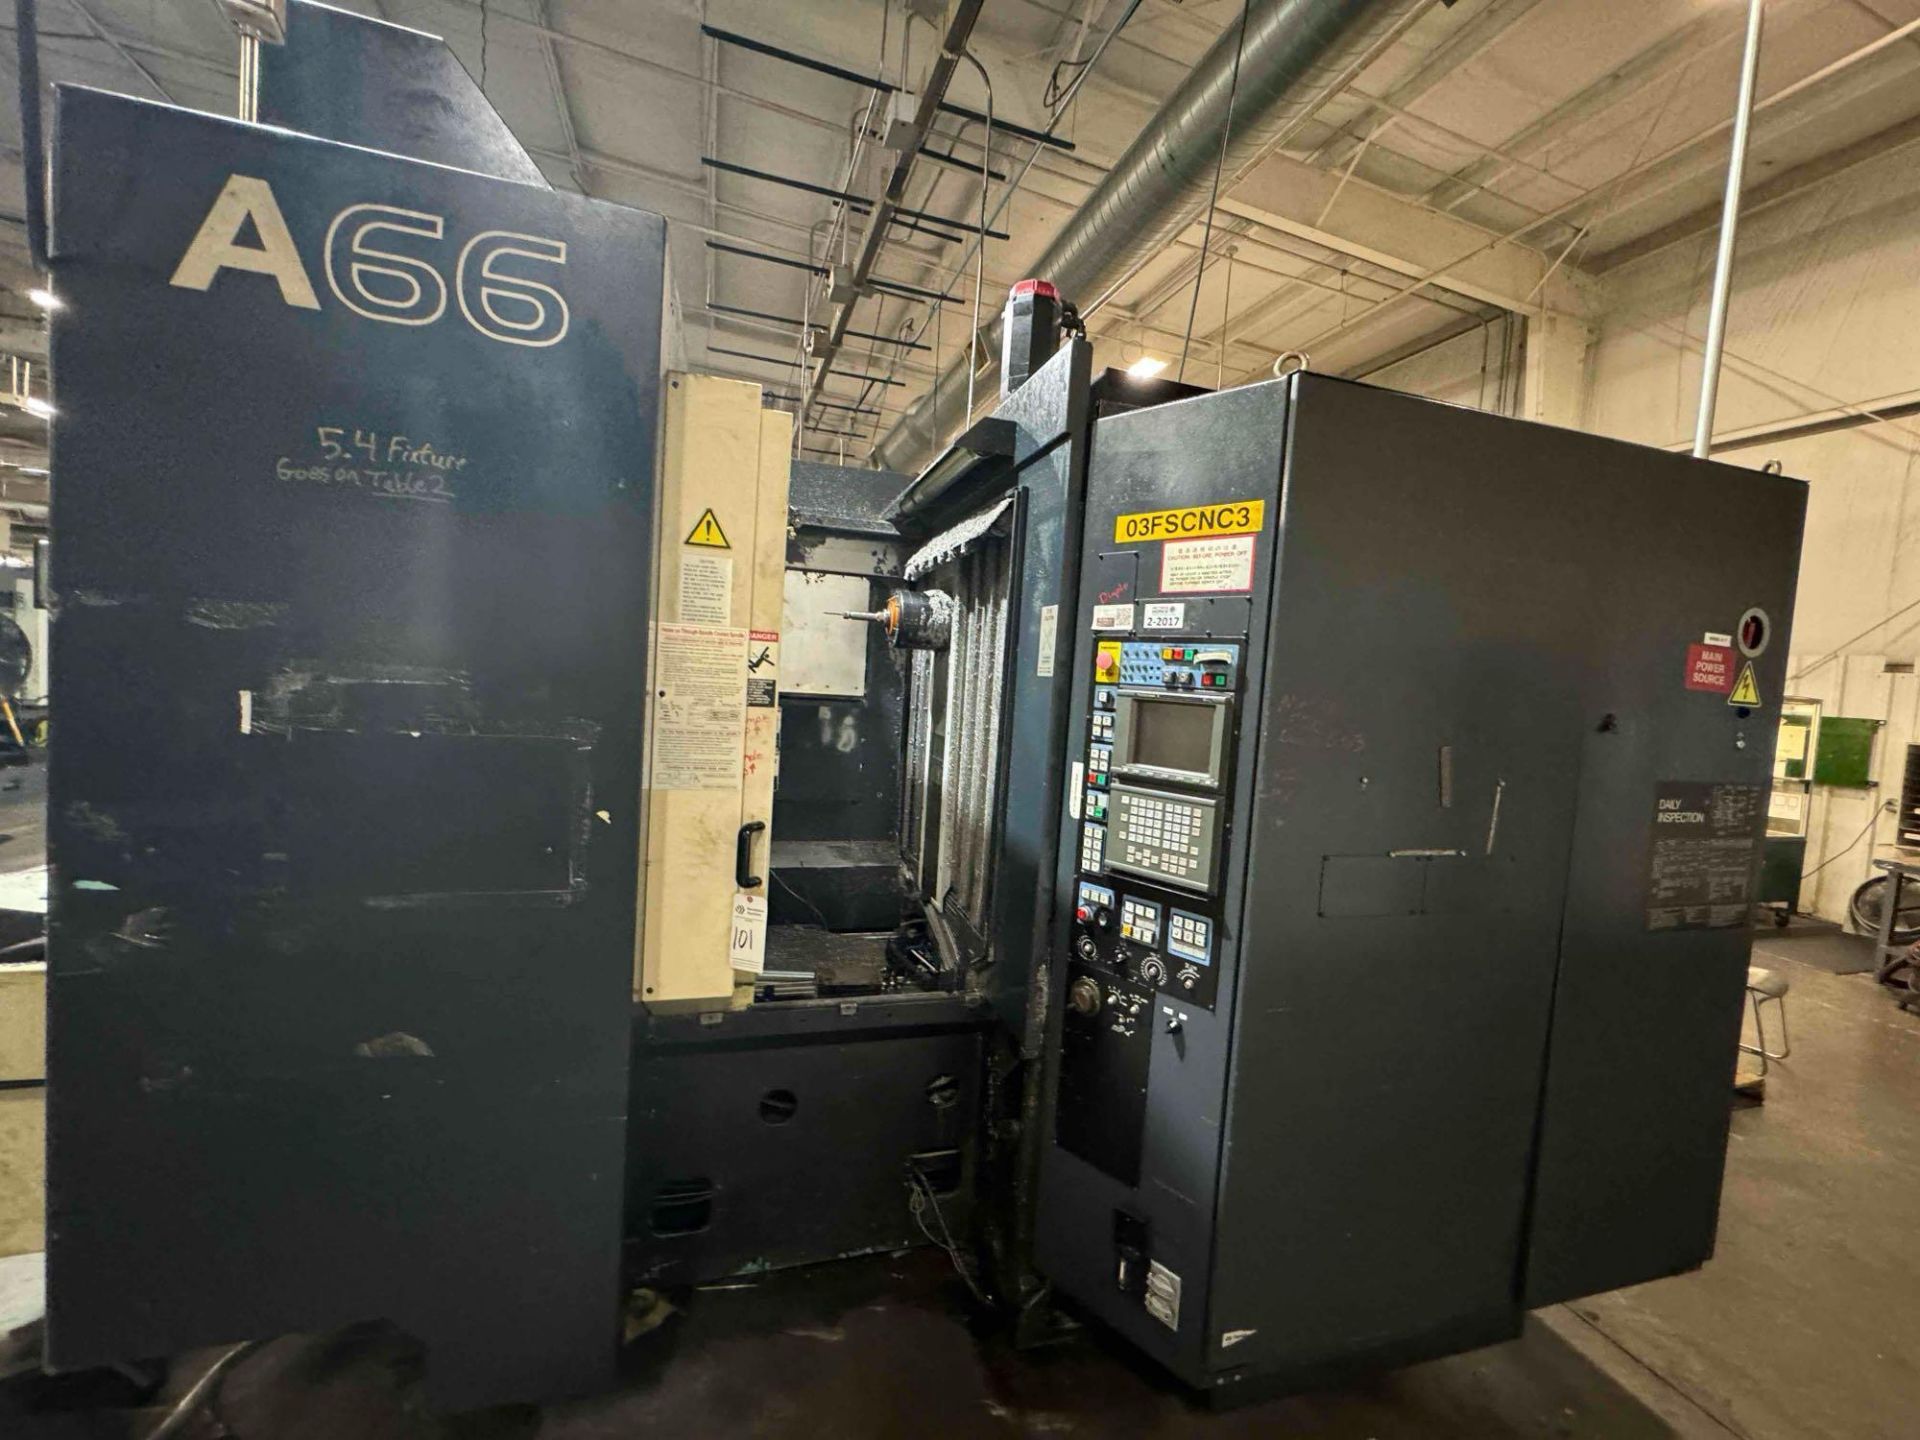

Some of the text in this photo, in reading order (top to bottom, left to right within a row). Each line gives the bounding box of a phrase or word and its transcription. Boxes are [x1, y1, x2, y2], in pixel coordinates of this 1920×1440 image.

[170, 174, 569, 347] A66
[317, 427, 376, 462] 5.4
[1126, 507, 1250, 537] 03FSCNC3
[1147, 616, 1180, 627] 2-2017
[750, 632, 777, 641] ANGER
[1701, 651, 1723, 662] MAIN
[1695, 660, 1725, 674] POWER
[1692, 672, 1725, 686] SOURCE
[1658, 799, 1682, 810] DAILY
[1657, 811, 1705, 823] INSPECTION
[733, 926, 753, 950] 101
